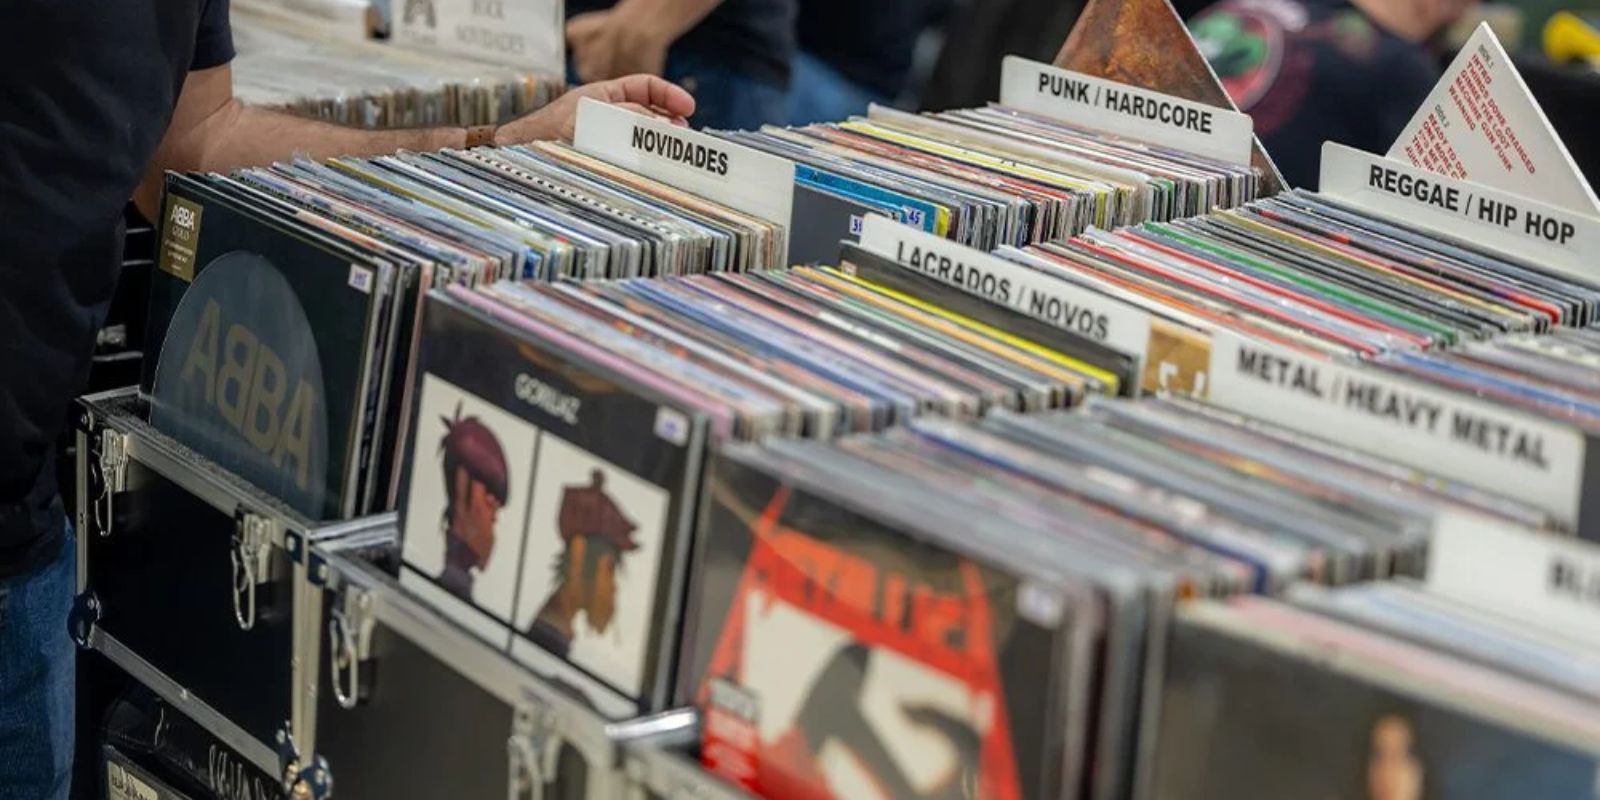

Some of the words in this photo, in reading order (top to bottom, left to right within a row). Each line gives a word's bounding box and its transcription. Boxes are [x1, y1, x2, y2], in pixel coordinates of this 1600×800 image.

[1472, 54, 1492, 84] INTRO
[1038, 72, 1090, 103] PUNK
[1095, 86, 1101, 106] /
[1105, 89, 1212, 134] HARDCORE
[1448, 84, 1476, 131] WARNING
[1456, 77, 1482, 121] MACHINE
[1481, 122, 1496, 144] GUN
[1494, 144, 1512, 172] FUNK
[1461, 70, 1481, 100] GIMME
[1481, 103, 1494, 122] THE
[1493, 123, 1510, 149] LOOT
[1467, 61, 1489, 98] THINGS
[1488, 98, 1506, 127] DONE
[1505, 126, 1535, 174] CHANGED
[632, 125, 728, 175] NOVIDADES
[1412, 135, 1424, 156] THE
[1423, 121, 1435, 141] ONE
[1434, 142, 1452, 171] MORE
[1428, 113, 1447, 144] READY
[1447, 147, 1457, 160] TO
[1455, 161, 1467, 179] DIE
[1428, 149, 1439, 164] ME
[171, 204, 195, 231] ABBA
[1369, 164, 1459, 212] REGGAE
[1465, 193, 1472, 216] /
[1478, 198, 1517, 227] HIP
[1525, 211, 1575, 244] HOP
[897, 240, 1011, 301] LACRADOS
[1017, 286, 1025, 305] /
[1030, 290, 1109, 341] NOVOS
[180, 298, 314, 487] ABBA
[1236, 346, 1322, 398] METAL
[1345, 380, 1441, 431] HEAVY
[1453, 411, 1549, 470] METAL
